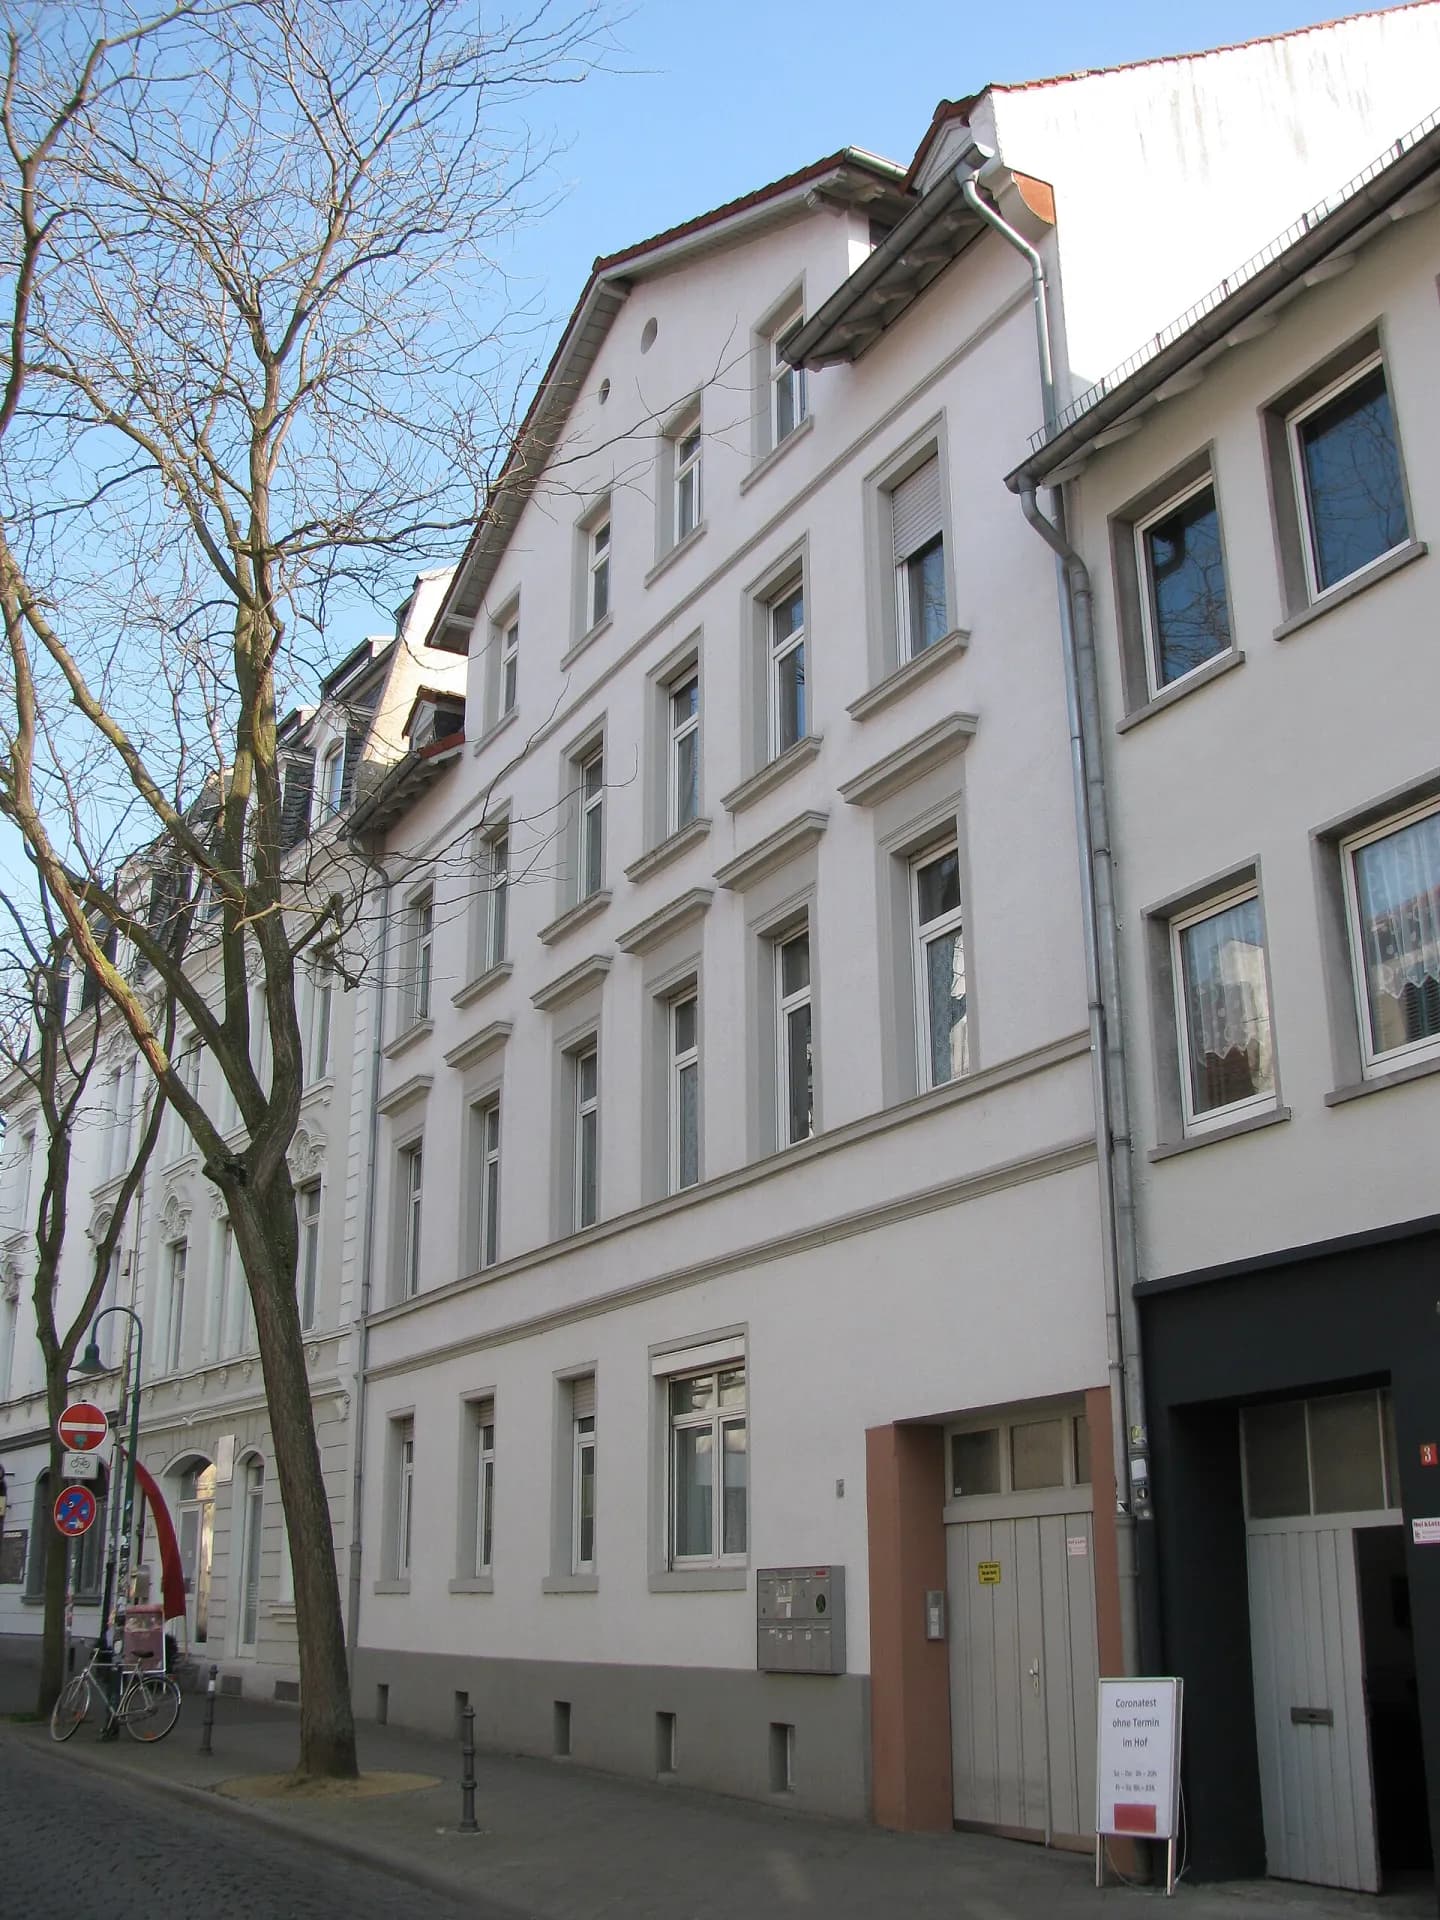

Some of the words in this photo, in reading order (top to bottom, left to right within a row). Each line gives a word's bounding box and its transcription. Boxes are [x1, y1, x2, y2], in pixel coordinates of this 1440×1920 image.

[1423, 1446, 1432, 1463] 3
[1115, 1698, 1157, 1709] Coronatest
[1112, 1717, 1131, 1728] ohne
[1133, 1717, 1160, 1728] Termin
[1122, 1738, 1132, 1748] im
[1134, 1738, 1148, 1748] Hof
